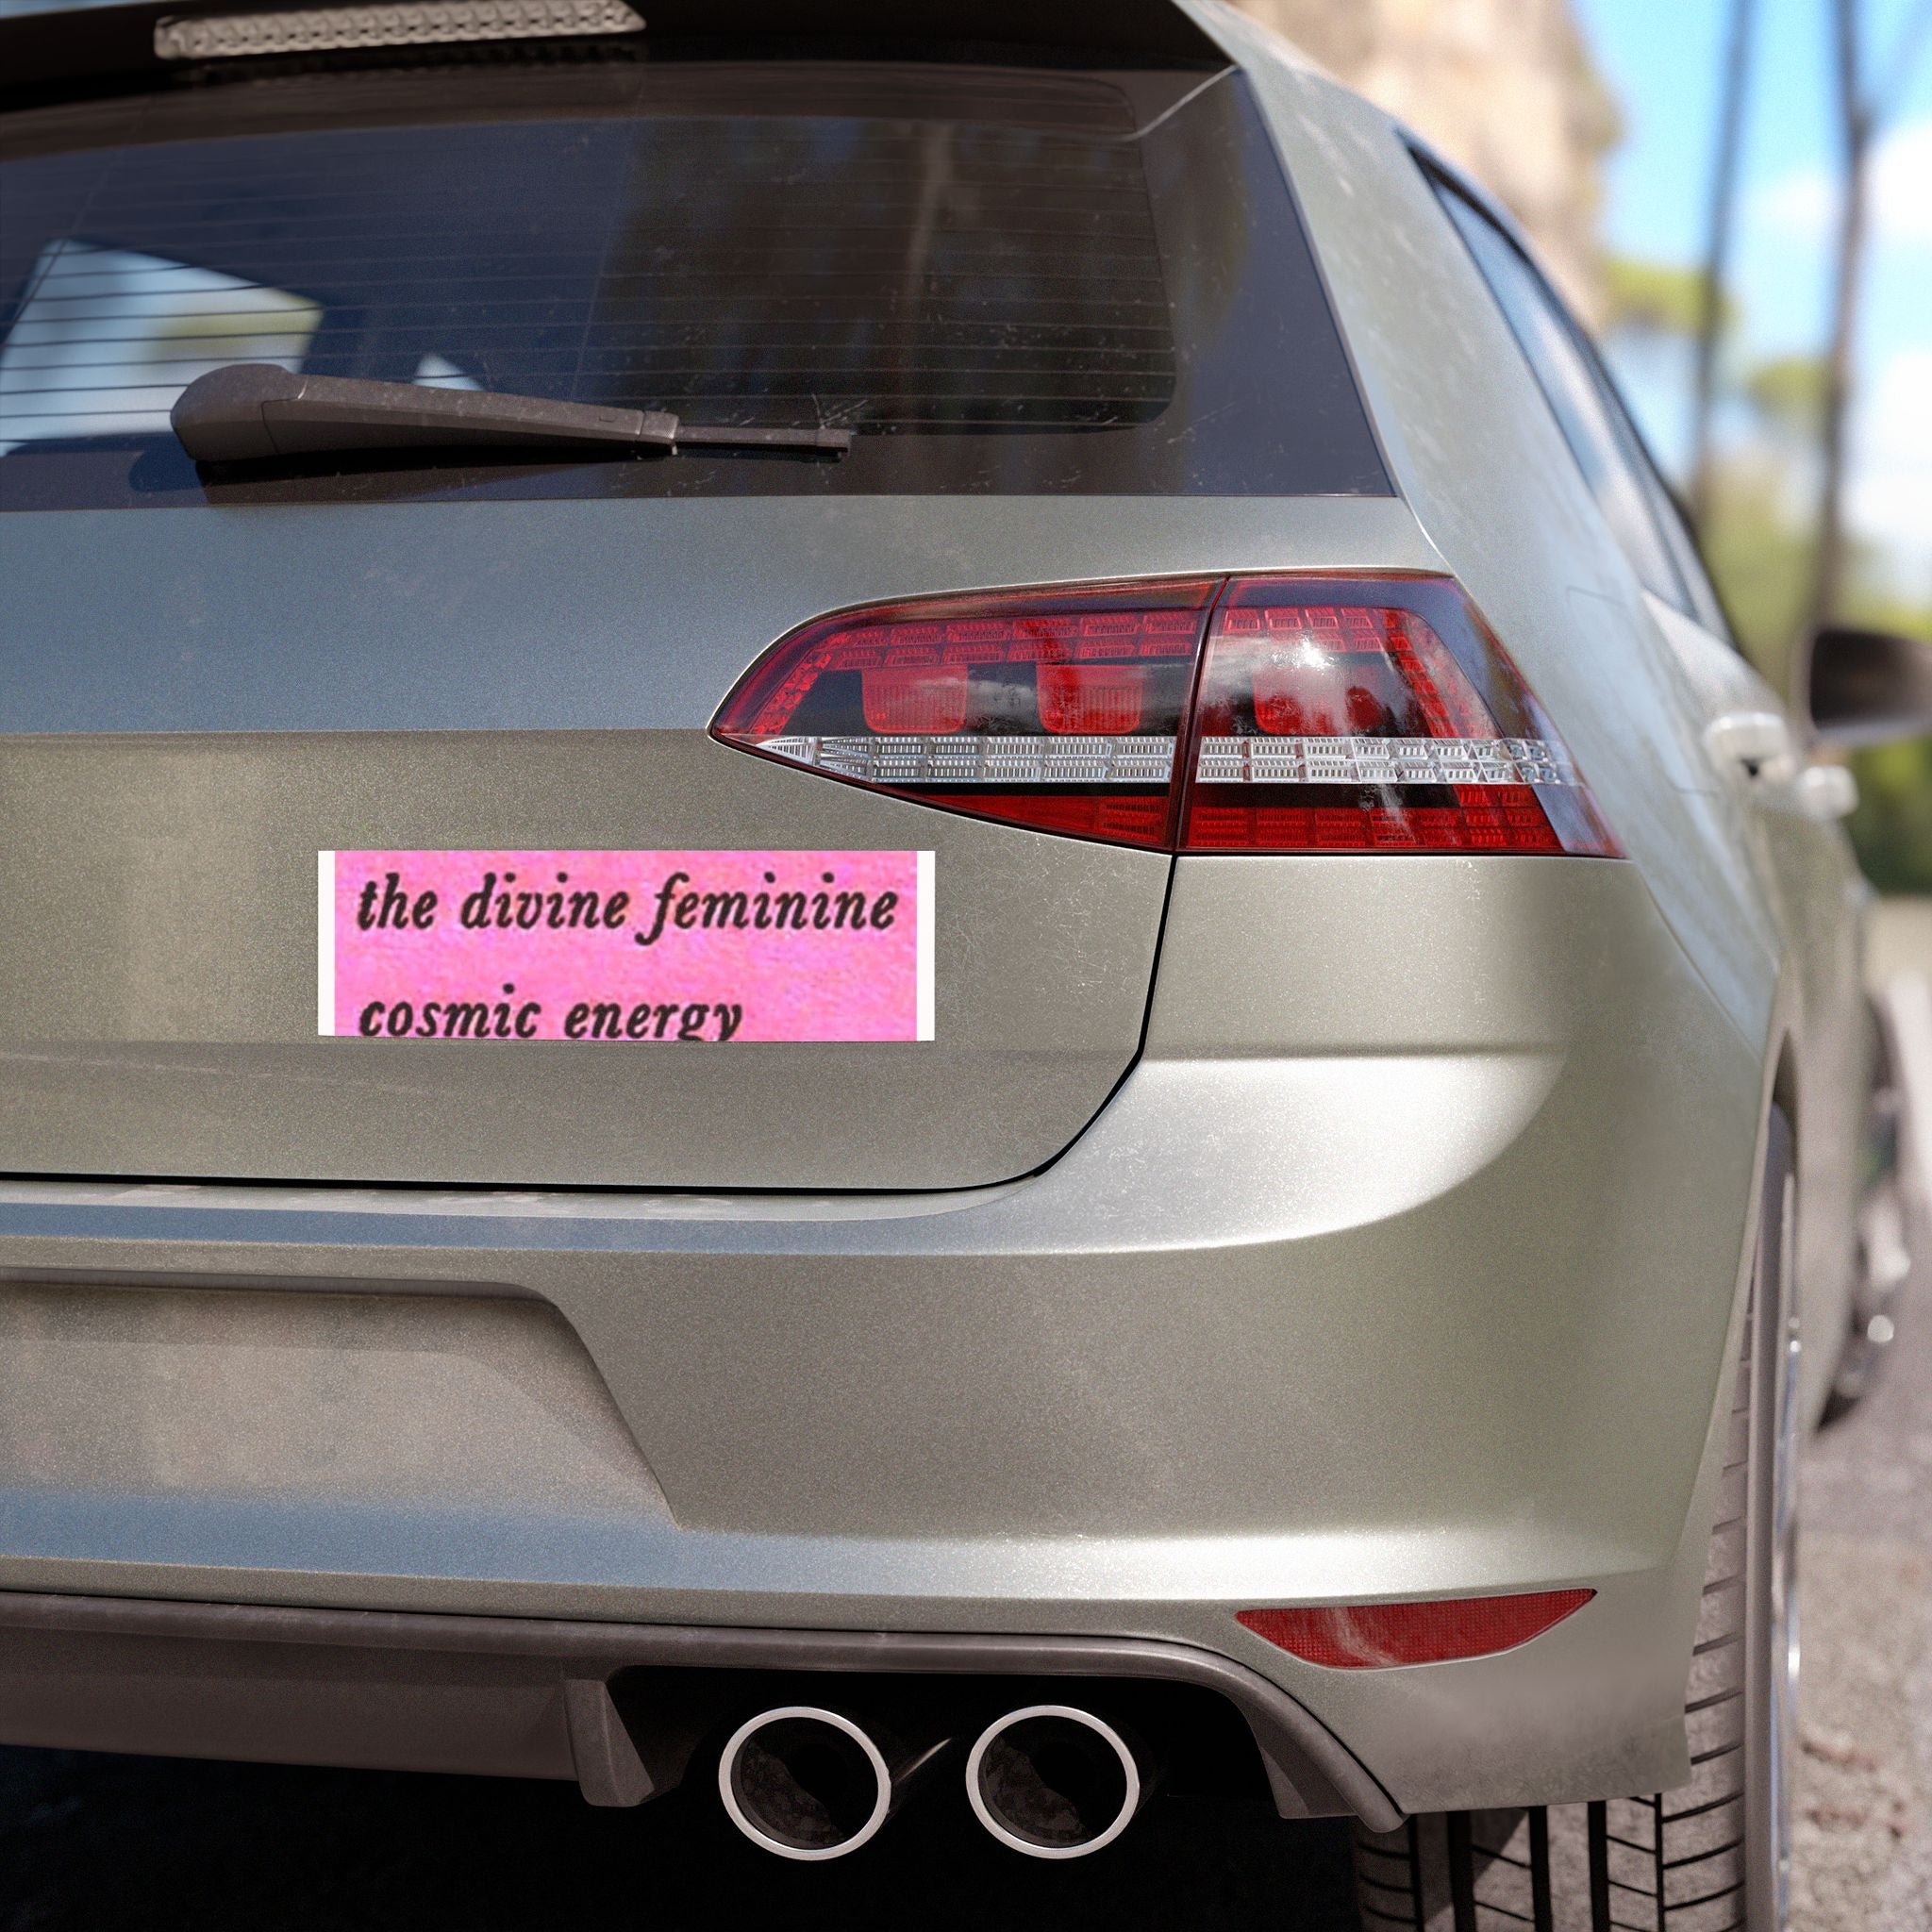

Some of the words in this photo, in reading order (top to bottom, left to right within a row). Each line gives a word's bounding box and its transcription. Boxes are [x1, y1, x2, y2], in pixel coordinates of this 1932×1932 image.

[358, 872, 438, 930] the
[460, 872, 629, 930] divine
[634, 872, 898, 946] feminine
[358, 983, 541, 1039] cosmic
[564, 1002, 742, 1042] energy
